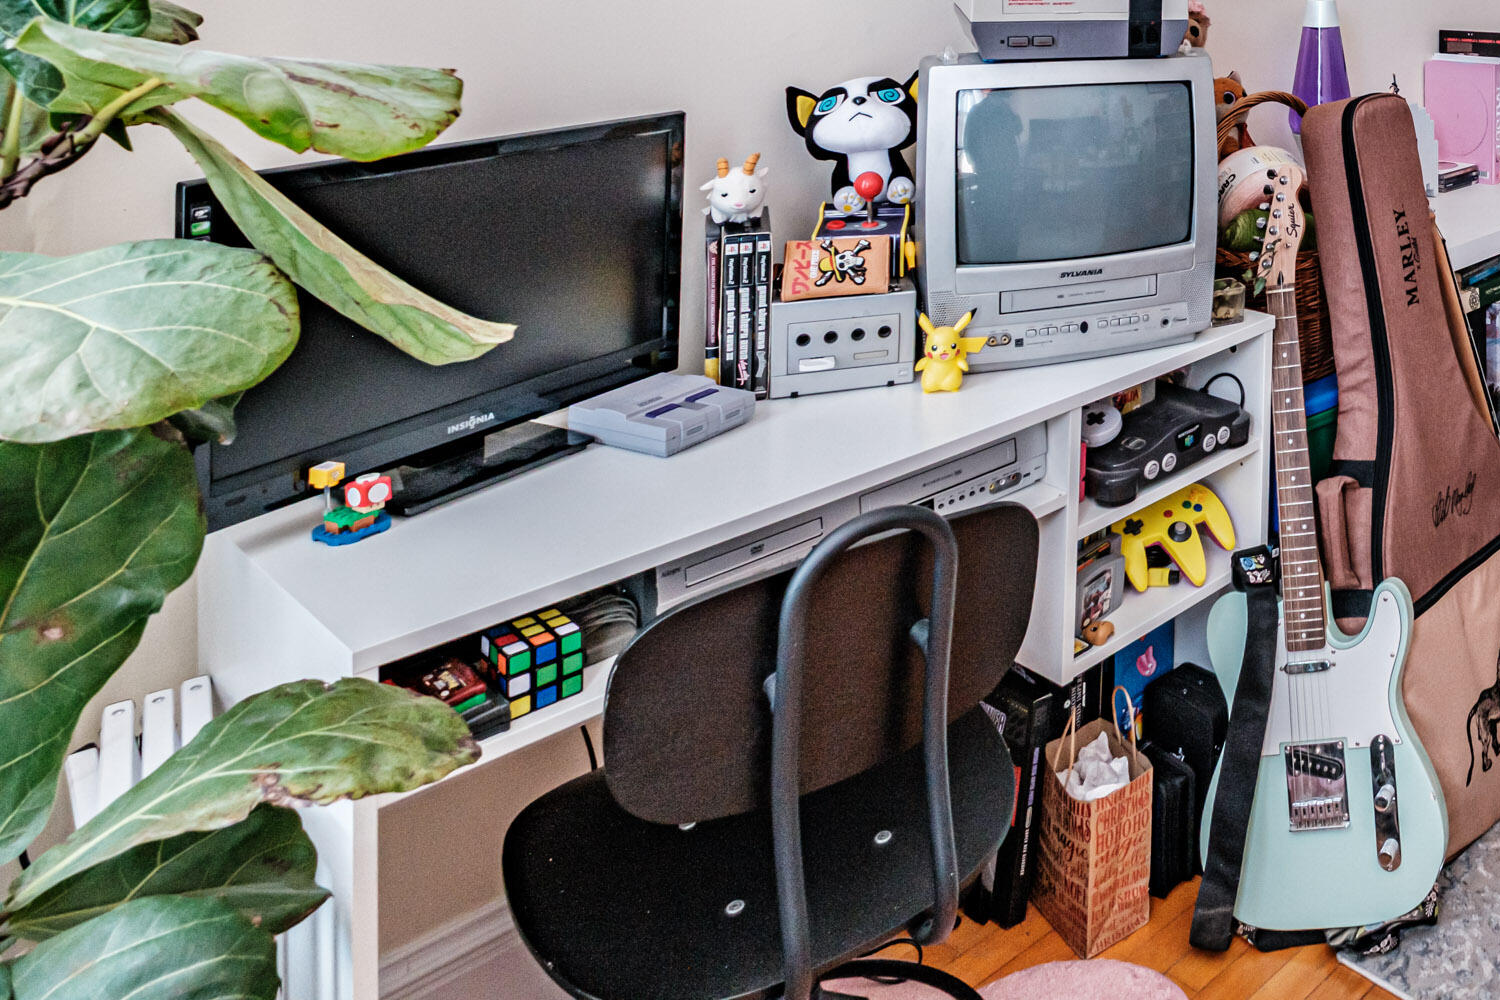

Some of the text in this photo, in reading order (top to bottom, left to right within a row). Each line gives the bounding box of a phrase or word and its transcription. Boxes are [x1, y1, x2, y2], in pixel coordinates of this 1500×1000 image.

[1286, 203, 1301, 238] Squier
[1059, 268, 1103, 279] SYLVANIA
[1393, 208, 1420, 307] MARLEY
[447, 411, 495, 434] INSIGNIA
[1096, 791, 1150, 834] CHRISTMAS
